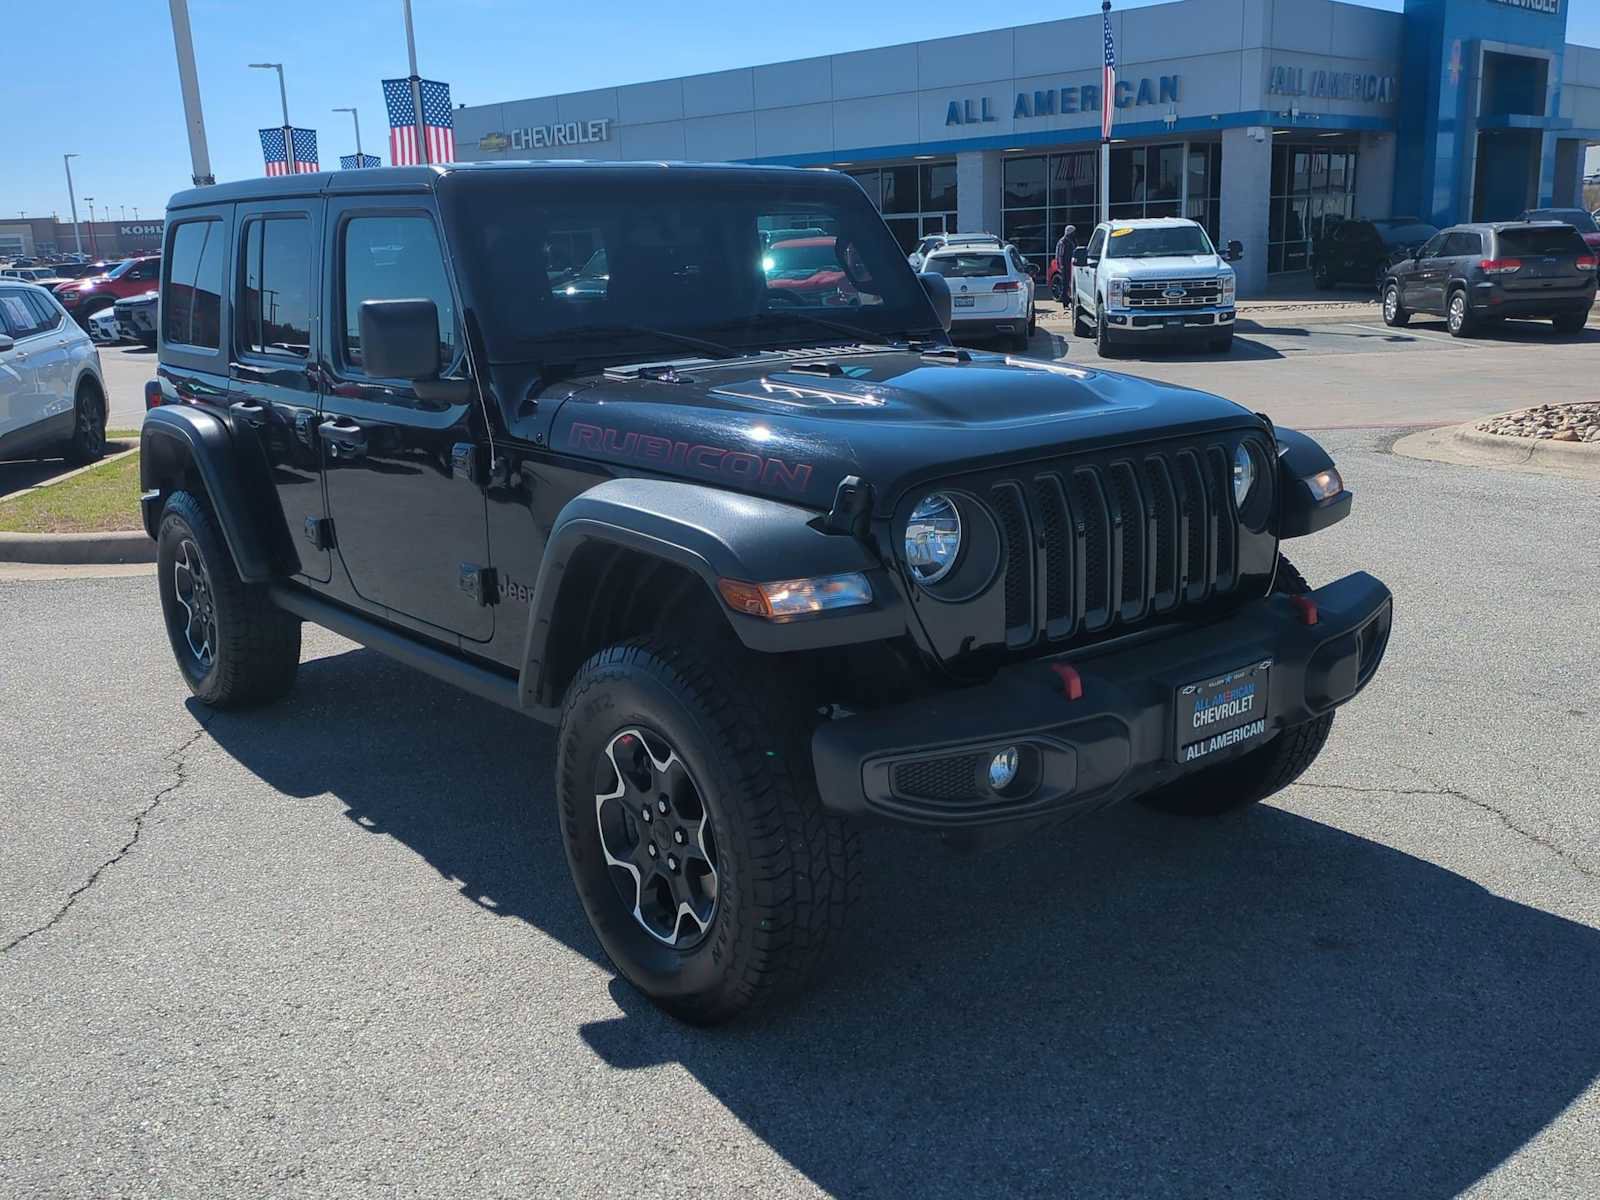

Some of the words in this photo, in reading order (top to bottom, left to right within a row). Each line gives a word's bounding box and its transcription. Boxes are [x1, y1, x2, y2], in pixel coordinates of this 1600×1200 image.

[945, 97, 998, 126] ALL
[1013, 75, 1181, 119] AMERCAN
[511, 119, 608, 150] CHEVROLET
[567, 421, 813, 493] RUBICON
[497, 573, 536, 607] Jeep
[1193, 694, 1254, 728] CHEVROLET
[1187, 742, 1207, 761] ALL
[1208, 719, 1265, 752] AMERICAN
